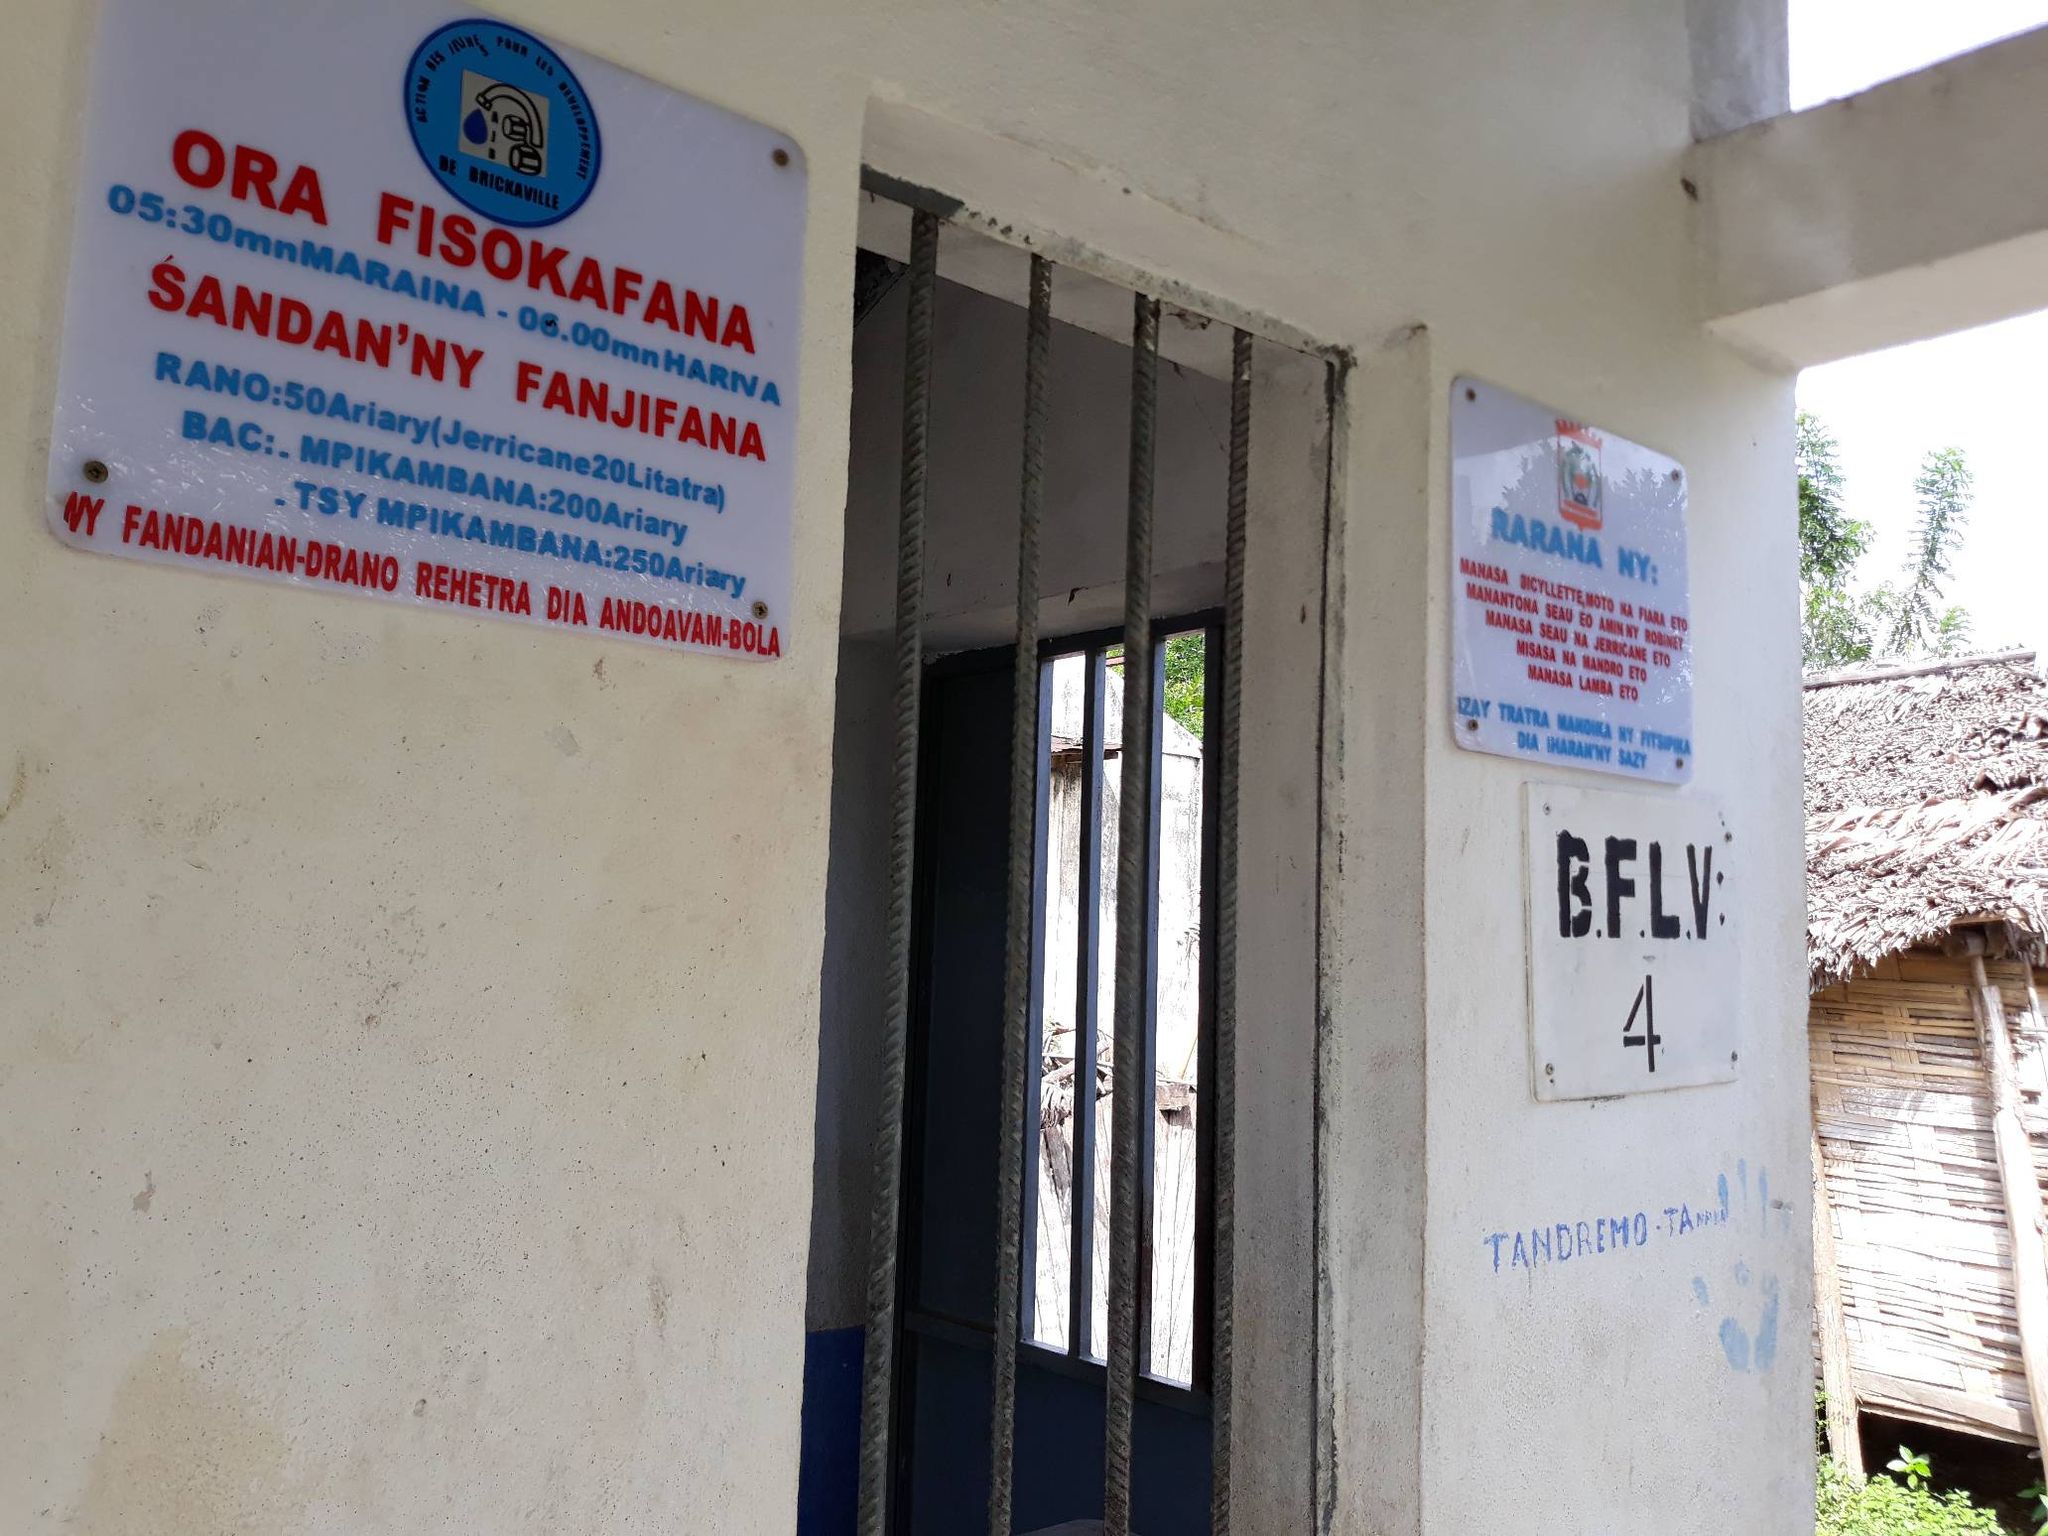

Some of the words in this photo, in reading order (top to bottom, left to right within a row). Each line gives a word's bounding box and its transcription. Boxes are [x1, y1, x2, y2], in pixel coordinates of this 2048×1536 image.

[496, 36, 528, 57] POUR
[535, 56, 553, 76] LES
[438, 155, 456, 176] DE
[469, 166, 559, 210] BRICKAVILLE
[172, 129, 328, 226] ORA
[377, 192, 756, 355] FISOKAFANA
[516, 361, 766, 461] FANJIFANA
[63, 491, 105, 536] NY
[121, 505, 399, 592] FANDANIAN-DRANO
[415, 561, 531, 616] REHETRA
[547, 586, 588, 626] DIA
[599, 597, 781, 658] ANDOAVAM-BOLA
[1491, 506, 1603, 569] RARANA
[1618, 546, 1658, 587] NY:
[1459, 557, 1508, 586] MANASA
[1620, 602, 1633, 618] NA
[1638, 606, 1666, 627] FIARA
[1670, 615, 1688, 632] ETO
[1466, 582, 1539, 615] MANANTONA
[1545, 602, 1573, 623] SEAU
[1485, 610, 1533, 636] MANASA
[1539, 623, 1568, 643] SEAU
[1574, 631, 1588, 648] NA
[1594, 637, 1647, 663] JERRICANE
[1653, 651, 1671, 668] ETO
[1516, 640, 1556, 663] MISASA
[1562, 650, 1577, 667] NA
[1582, 655, 1623, 678] MANDRO
[1629, 665, 1647, 682] ETO
[1528, 664, 1573, 688] MANASA
[1579, 675, 1613, 696] LAMBA
[1620, 684, 1638, 701] ETO
[1458, 697, 1490, 719] IZAY
[1498, 703, 1550, 729] TRATRA
[1618, 726, 1634, 743] NY
[1517, 731, 1539, 752] DIA
[1618, 748, 1647, 769] SAZY
[1622, 974, 1661, 1073] 4
[1483, 1212, 1648, 1274] TANDREMO
